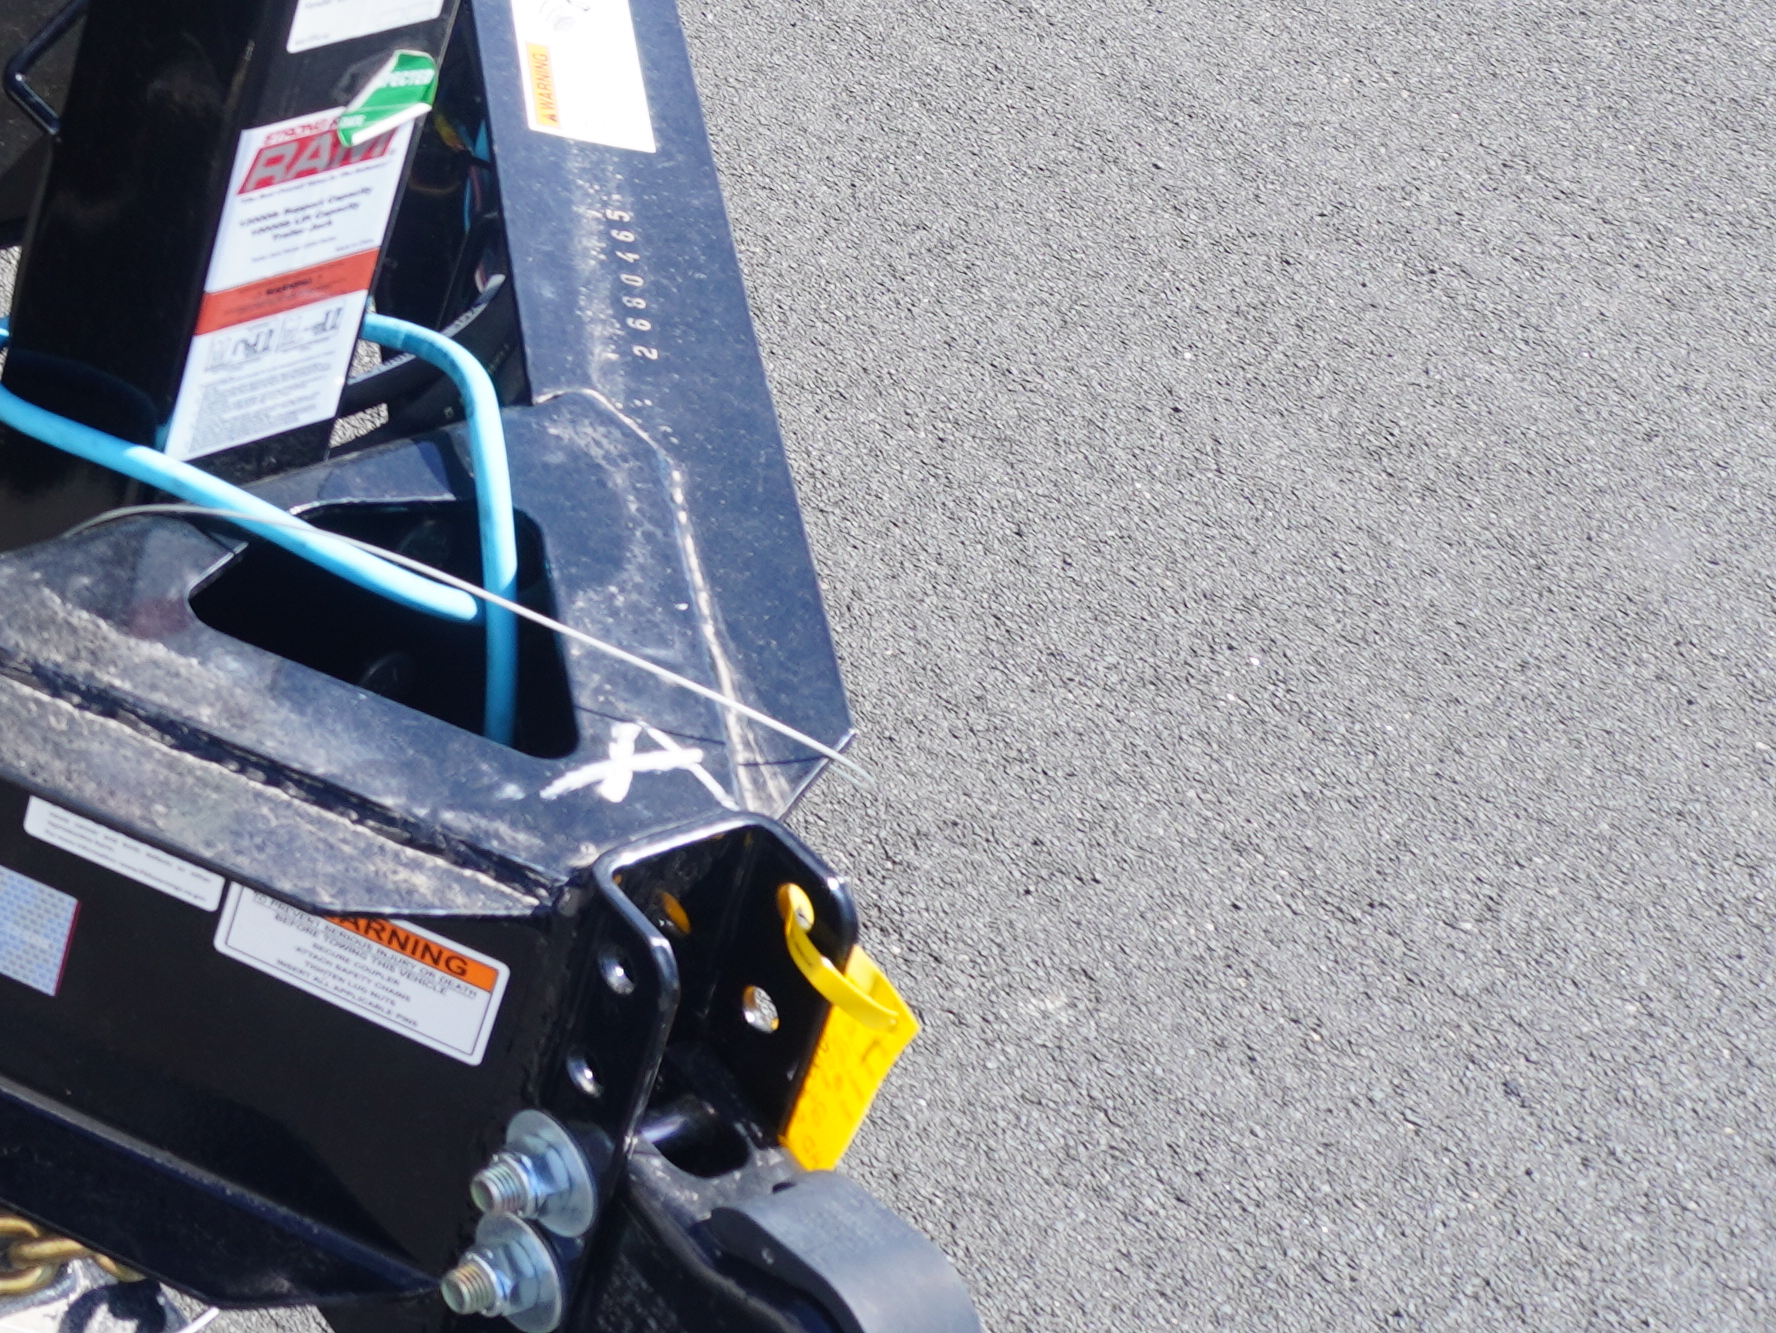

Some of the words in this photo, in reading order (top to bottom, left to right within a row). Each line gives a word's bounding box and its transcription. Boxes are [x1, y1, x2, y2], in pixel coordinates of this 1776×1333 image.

[533, 53, 554, 111] WARNING
[605, 208, 660, 360] 2680465
[275, 914, 317, 939] BEFORE
[322, 932, 368, 961] TOWING
[371, 952, 398, 973] THIS
[399, 965, 448, 995] VEHICLE
[331, 917, 469, 977] ARNING
[438, 971, 478, 998] DEATH
